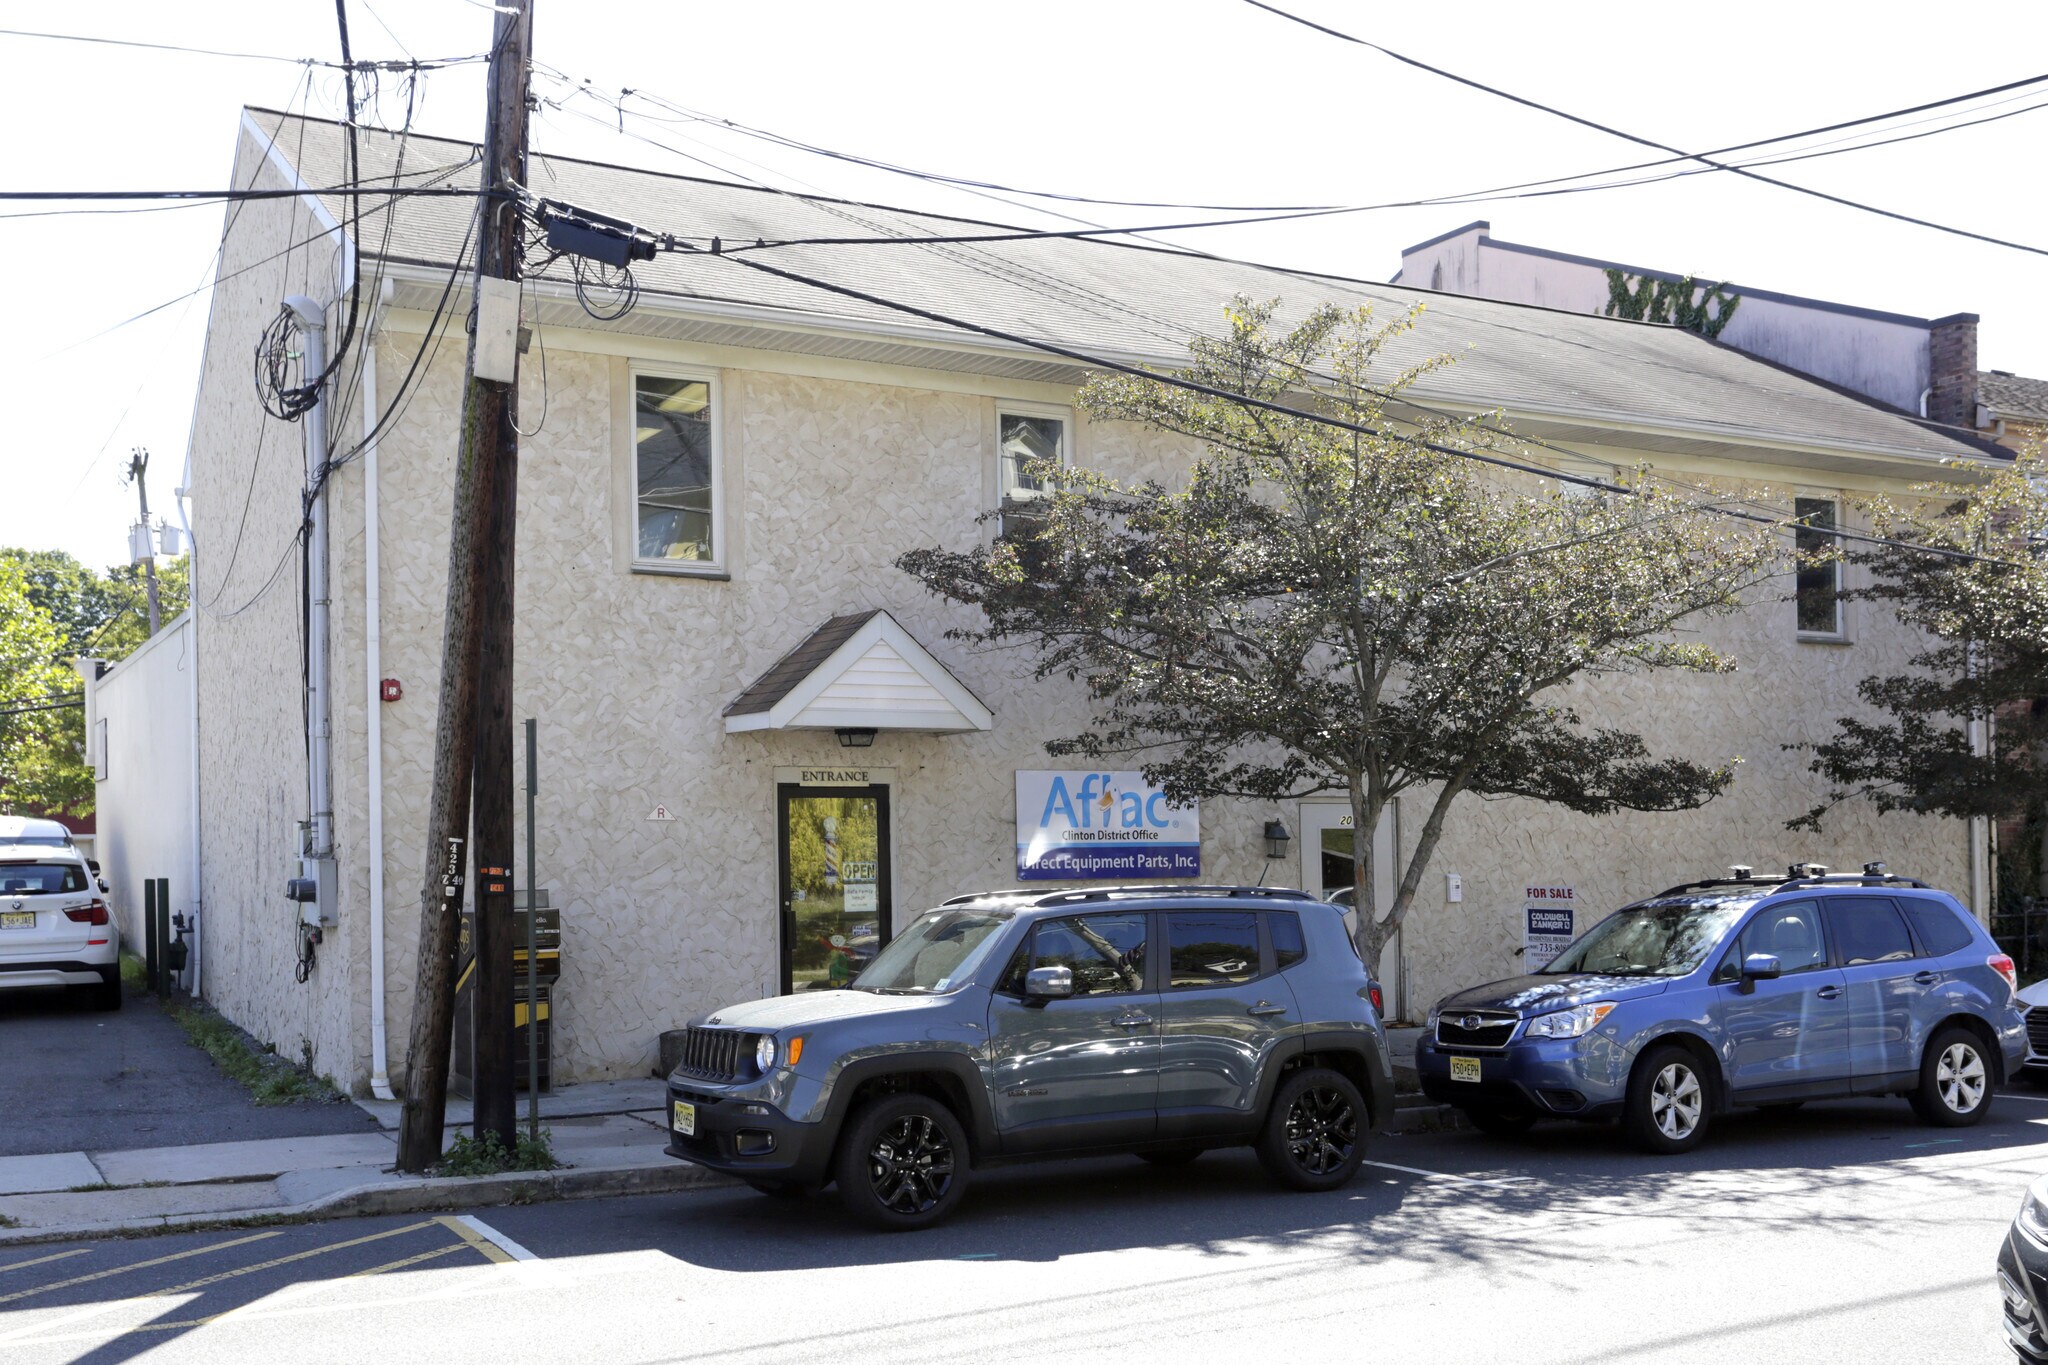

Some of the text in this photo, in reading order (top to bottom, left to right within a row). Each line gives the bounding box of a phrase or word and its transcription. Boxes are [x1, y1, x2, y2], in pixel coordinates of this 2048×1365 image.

[801, 771, 869, 781] ENTRANCE
[1040, 773, 1169, 828] Aflac
[657, 808, 665, 818] R
[1341, 816, 1352, 825] 20
[1062, 829, 1158, 840] Clinton District Office
[1064, 855, 1134, 872] Equipment
[1137, 854, 1172, 869] Parts,
[1175, 854, 1197, 868] Inc.
[844, 863, 875, 878] OPEN
[1527, 888, 1573, 899] FOR SALE
[1532, 921, 1563, 929] BANKER
